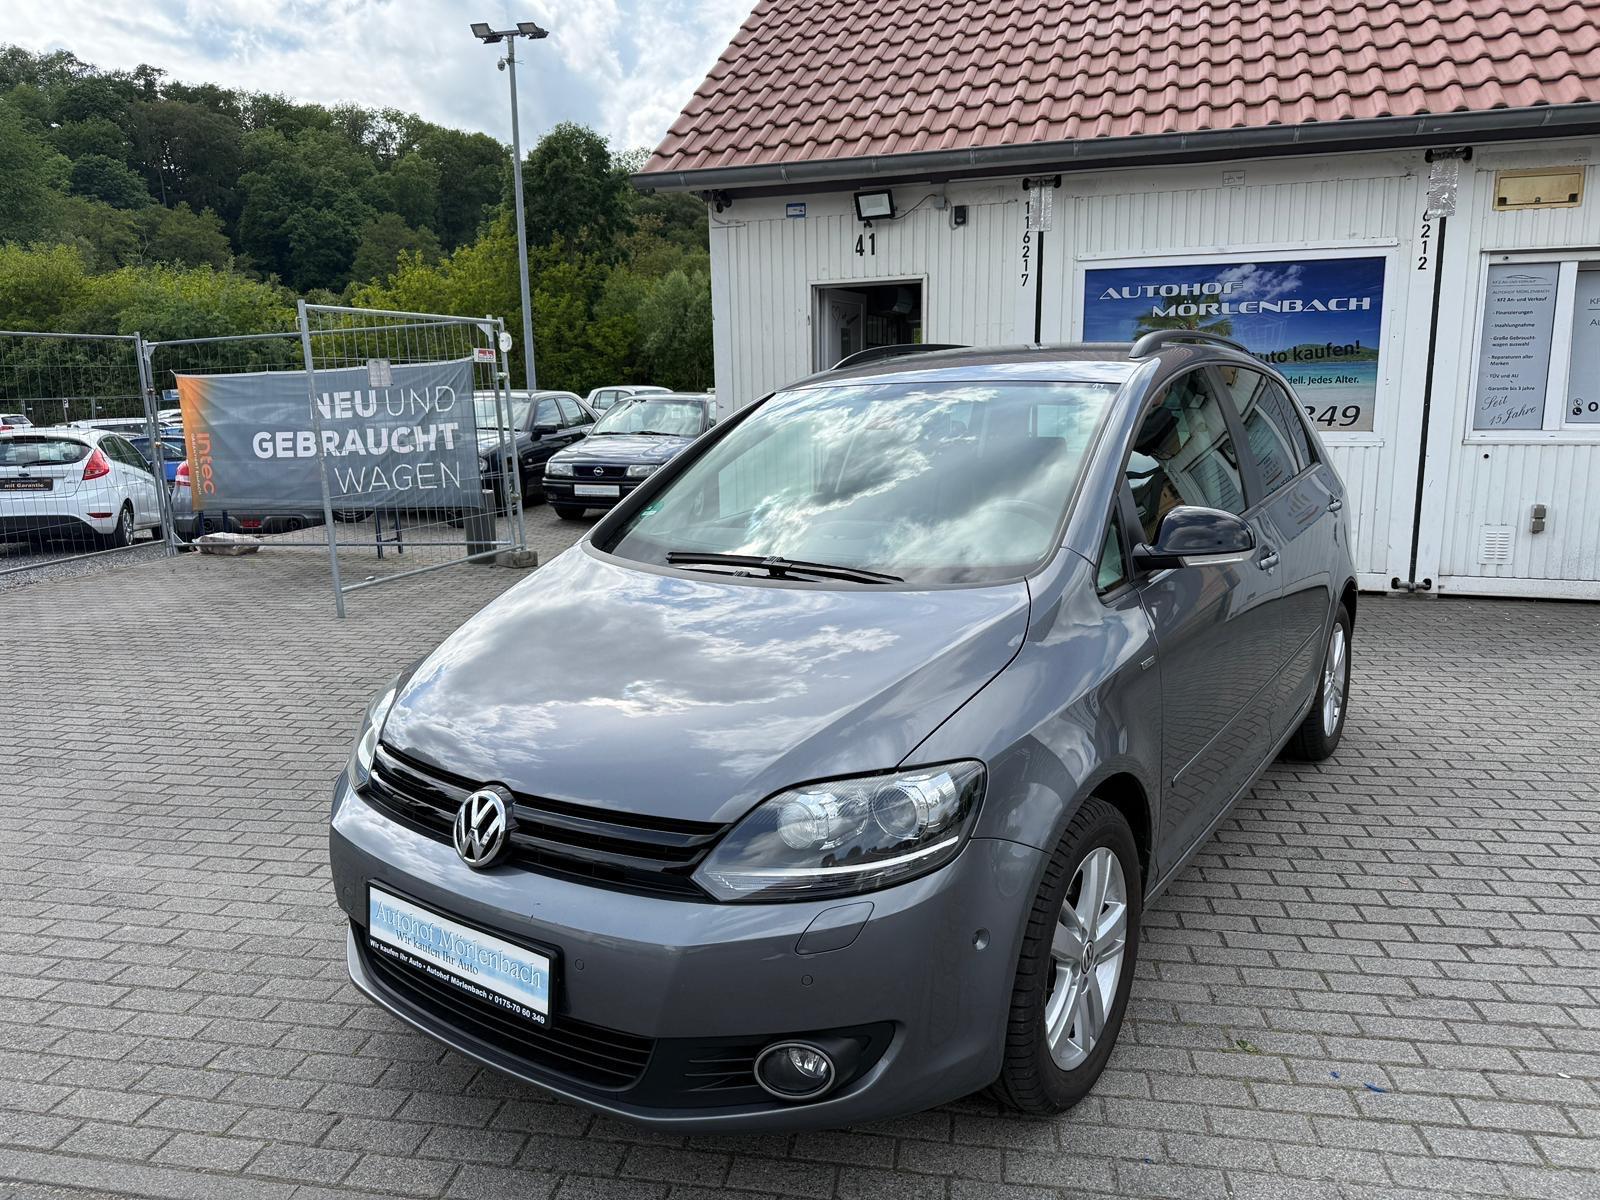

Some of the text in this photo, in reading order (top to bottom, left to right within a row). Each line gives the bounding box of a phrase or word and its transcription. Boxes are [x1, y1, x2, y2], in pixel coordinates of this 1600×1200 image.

[855, 232, 876, 257] 41
[1098, 280, 1244, 300] AUTOHOF
[1151, 296, 1371, 318] MÖRLENBACH
[1293, 339, 1361, 362] kaufen!
[1307, 375, 1333, 386] Jedes
[1334, 374, 1360, 384] Alter.
[309, 385, 456, 420] NEU UND
[1502, 404, 1537, 425] Jahre
[1304, 404, 1362, 427] 349
[252, 422, 459, 459] GEBRAUCHT
[334, 460, 461, 494] WAGEN
[375, 901, 542, 989] Autohof Mörlenbach
[395, 929, 479, 975] Wir kaufen Ihr Auto
[369, 938, 380, 949] Wir
[379, 943, 399, 958] kaufen
[408, 956, 422, 969] Auto
[426, 965, 450, 982] Autohof
[450, 975, 488, 998] Mörlenbach
[531, 1012, 545, 1024] 349
